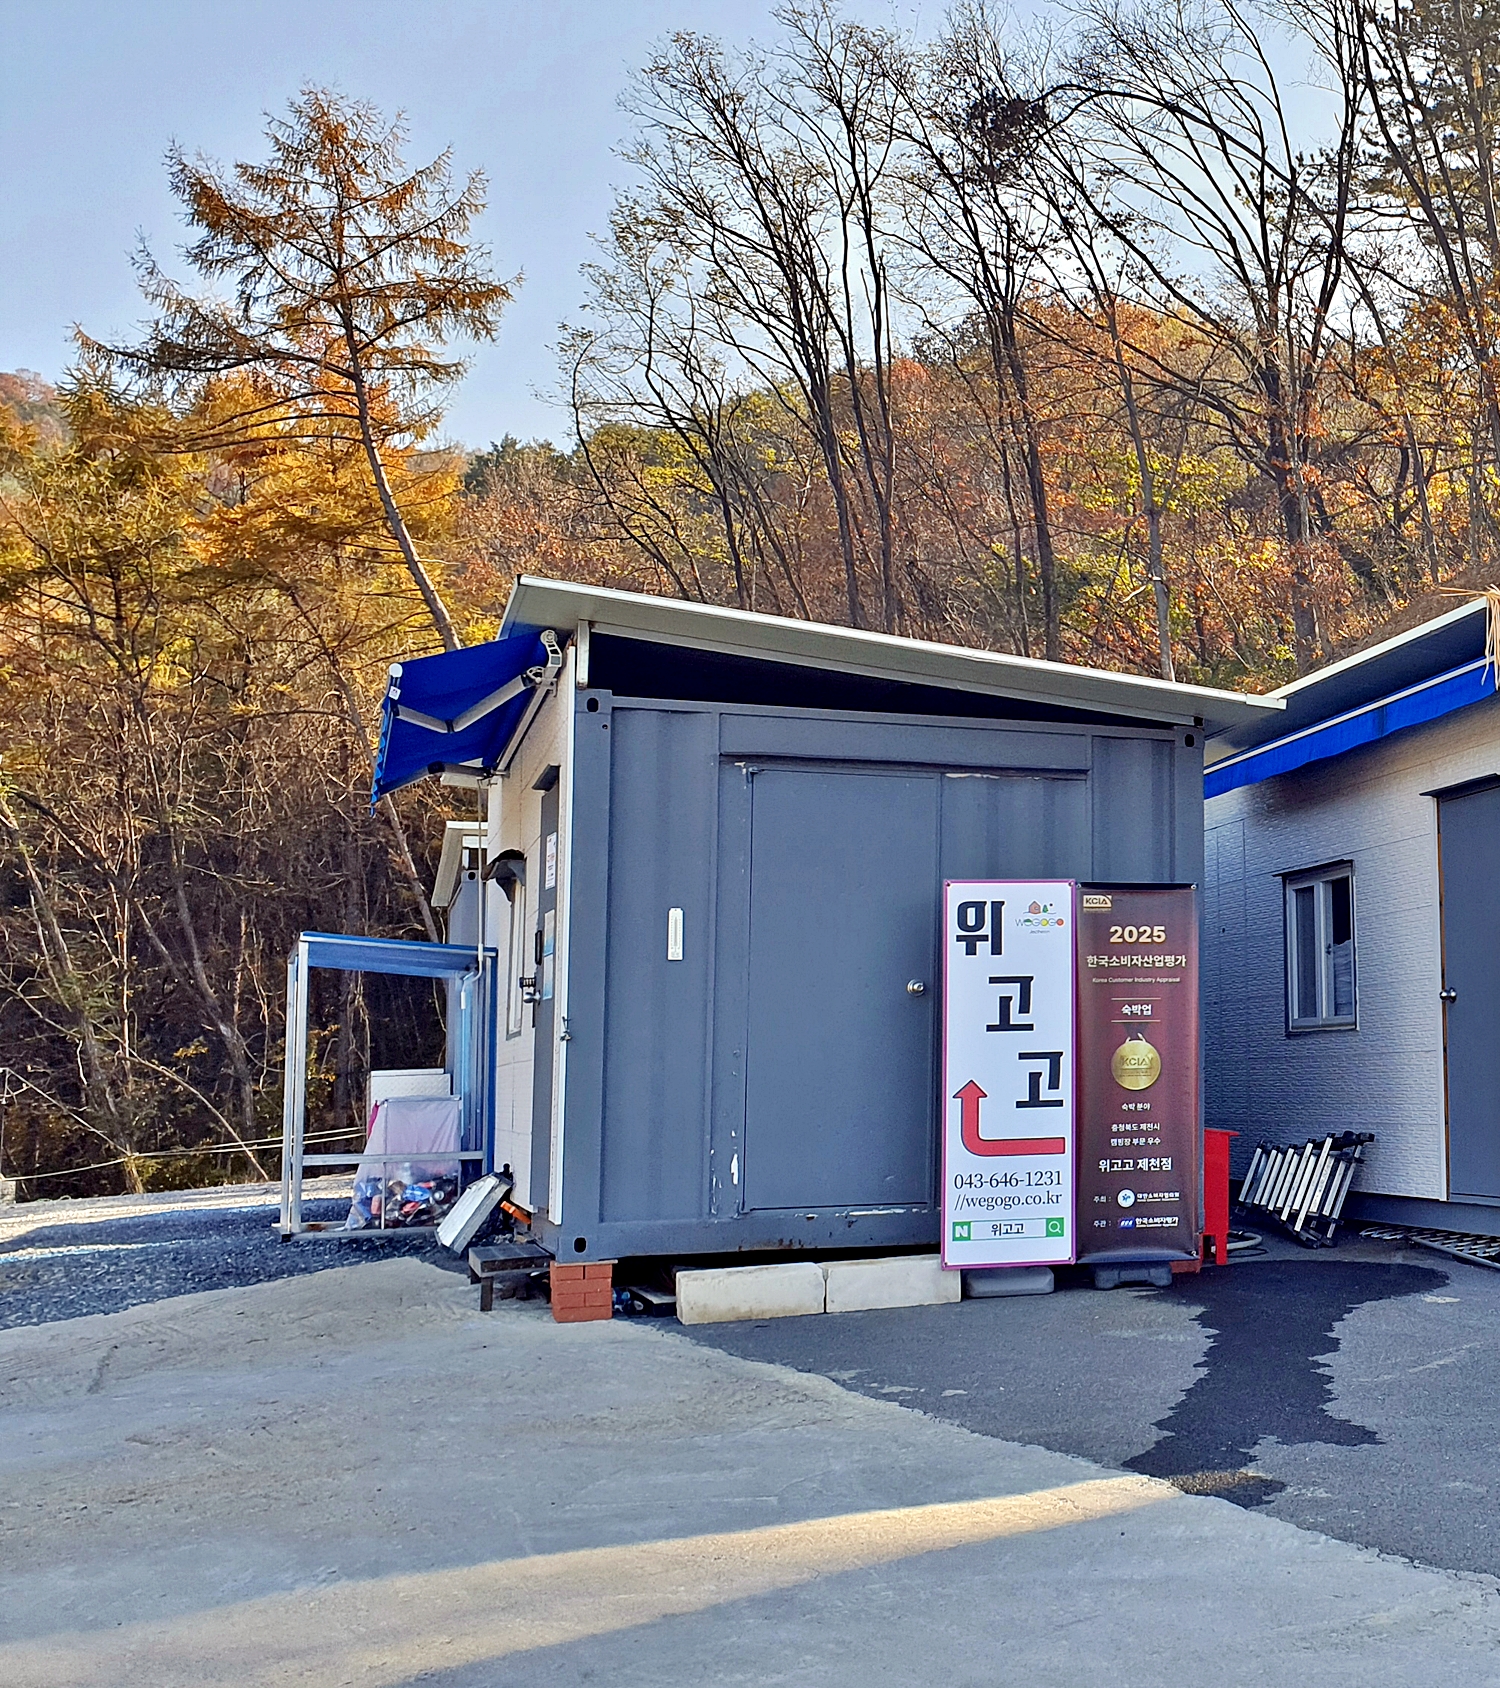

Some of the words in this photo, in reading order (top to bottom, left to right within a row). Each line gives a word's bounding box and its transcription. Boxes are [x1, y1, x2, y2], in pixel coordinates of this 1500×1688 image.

[1085, 897, 1108, 905] KCIA
[1109, 925, 1167, 944] 2025
[1086, 955, 1187, 969] 한국소비자산업평가
[1134, 976, 1156, 984] Industry
[1156, 976, 1180, 984] Appraisal
[1121, 1003, 1152, 1016] 숙박업
[1098, 1158, 1135, 1173] 위고고
[1136, 1157, 1172, 1171] 제천점
[953, 1170, 1063, 1190] 043-646-1231
[953, 1190, 1063, 1212] //wegogo.co.kr
[990, 1222, 1025, 1237] 위고고
